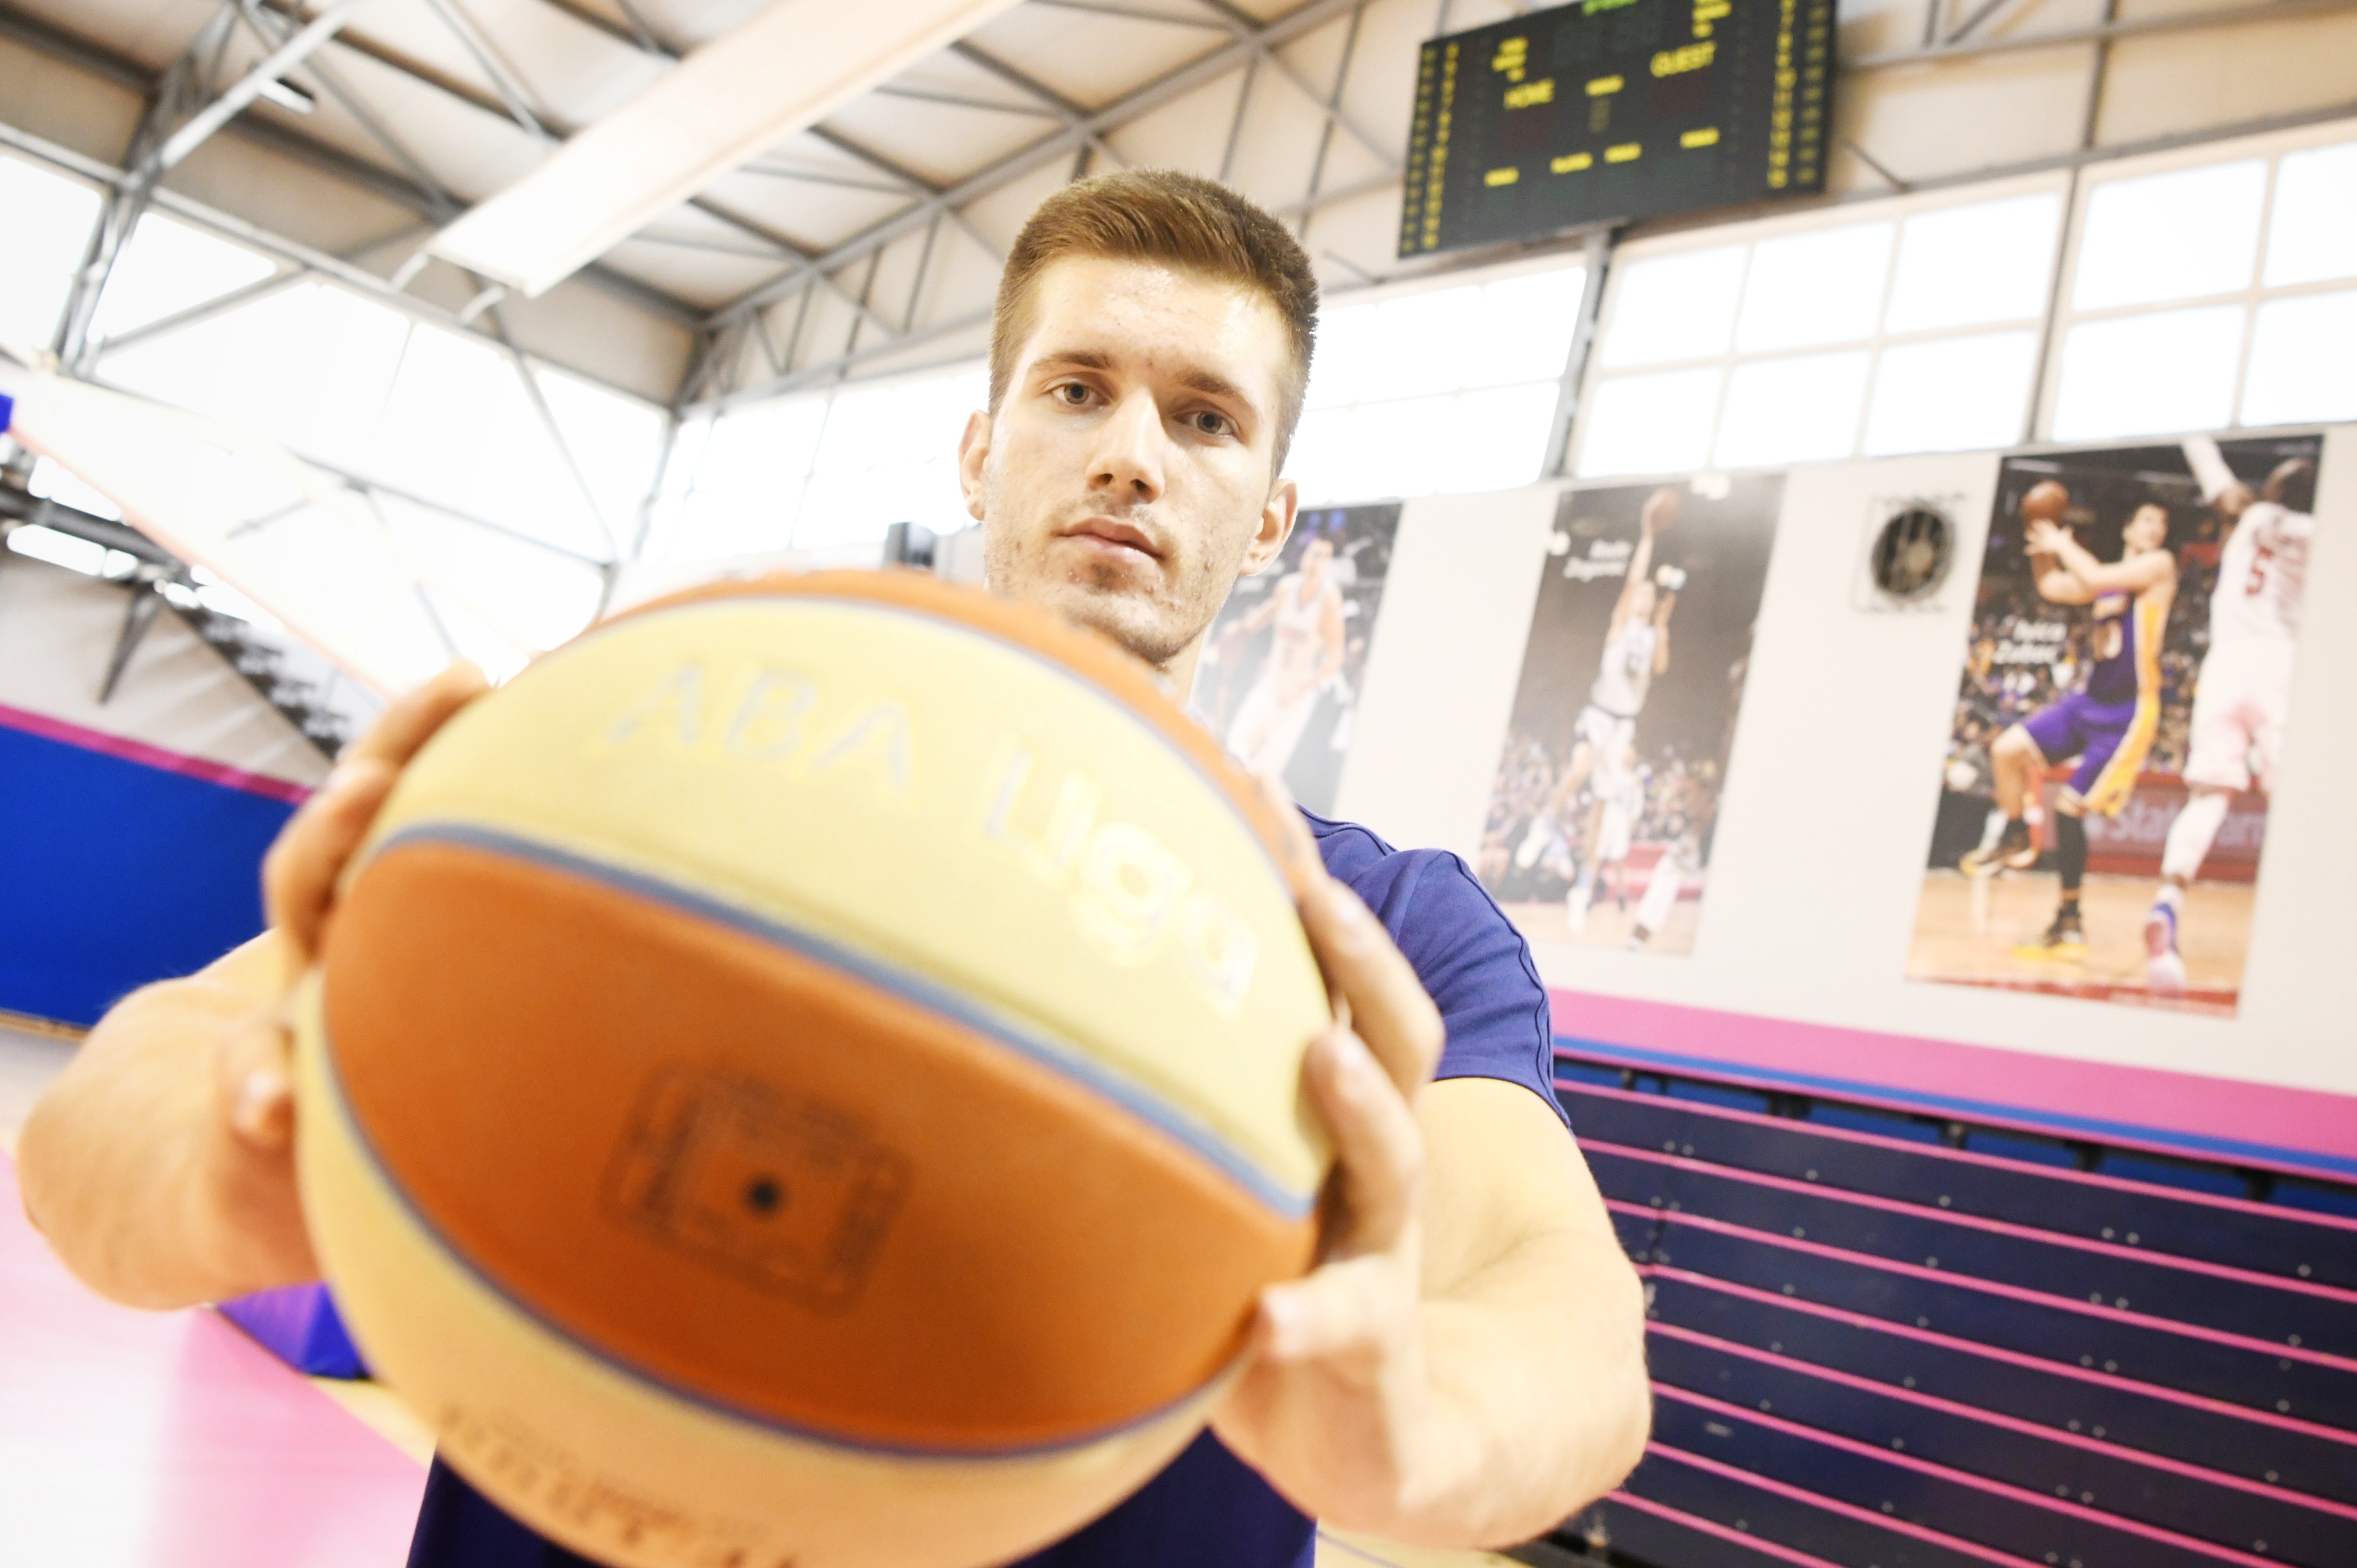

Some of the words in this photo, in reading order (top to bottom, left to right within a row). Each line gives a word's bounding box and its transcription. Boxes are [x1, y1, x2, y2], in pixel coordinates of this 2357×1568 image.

[1650, 40, 1716, 78] GUEST
[1504, 77, 1555, 109] HOME
[609, 658, 916, 794] ABA
